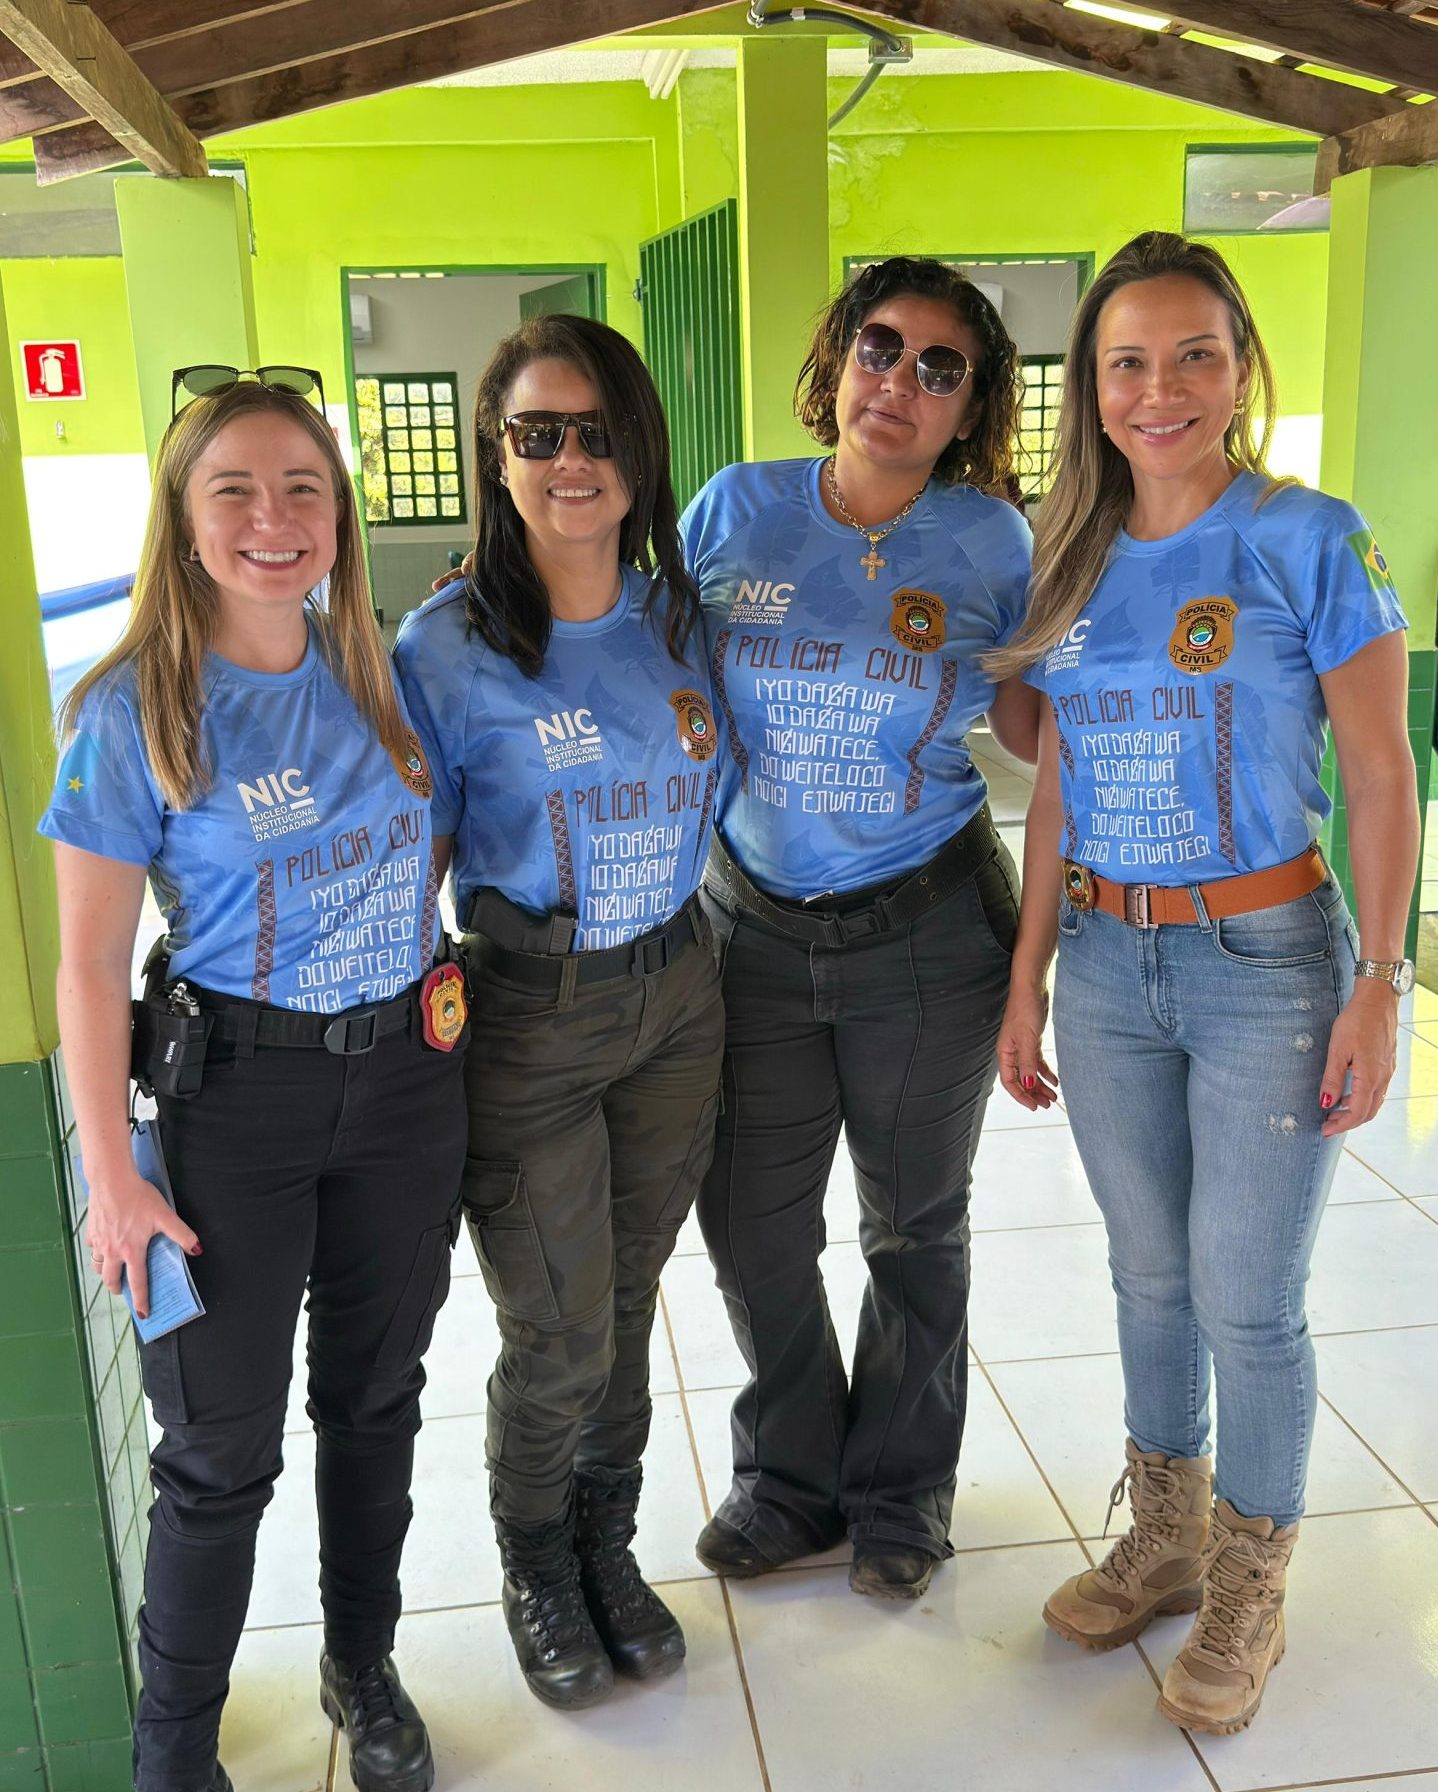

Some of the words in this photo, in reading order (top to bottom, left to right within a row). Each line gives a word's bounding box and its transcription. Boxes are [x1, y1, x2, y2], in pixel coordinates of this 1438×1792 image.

[735, 579, 796, 605] NIC
[901, 595, 937, 609] POLÍCIA
[730, 611, 785, 619] INSTITUCIONAL
[732, 602, 762, 611] NÚCLEO
[1186, 604, 1227, 616] POLÍCIA
[738, 617, 783, 625] CIDADANIA
[903, 634, 932, 646] CIVIL
[1054, 619, 1092, 648] IC
[736, 635, 844, 674] POLÍCIA
[865, 647, 929, 690] CIVIL
[1180, 654, 1214, 664] CIVIL
[1058, 688, 1134, 725] POLÍCIA
[1152, 686, 1206, 721] CIVIL
[534, 708, 598, 746] NIC
[546, 744, 602, 764] INSTITUCIONAL
[691, 743, 711, 752] CIVIL
[548, 762, 561, 772] DA
[562, 753, 604, 768] CIDADANIA
[237, 768, 310, 813] NIC
[412, 780, 430, 789] CIVIL
[666, 772, 702, 814] CIVIL
[754, 775, 787, 809] NOIGI
[249, 805, 288, 824] NÚCLEO
[252, 807, 318, 833] INSTITUCIONAL
[255, 831, 271, 842] DA
[272, 815, 320, 837] CIDADANIA
[286, 825, 373, 887] POLÍCIA
[388, 808, 424, 850] CIV
[1080, 839, 1110, 863] NOIGI
